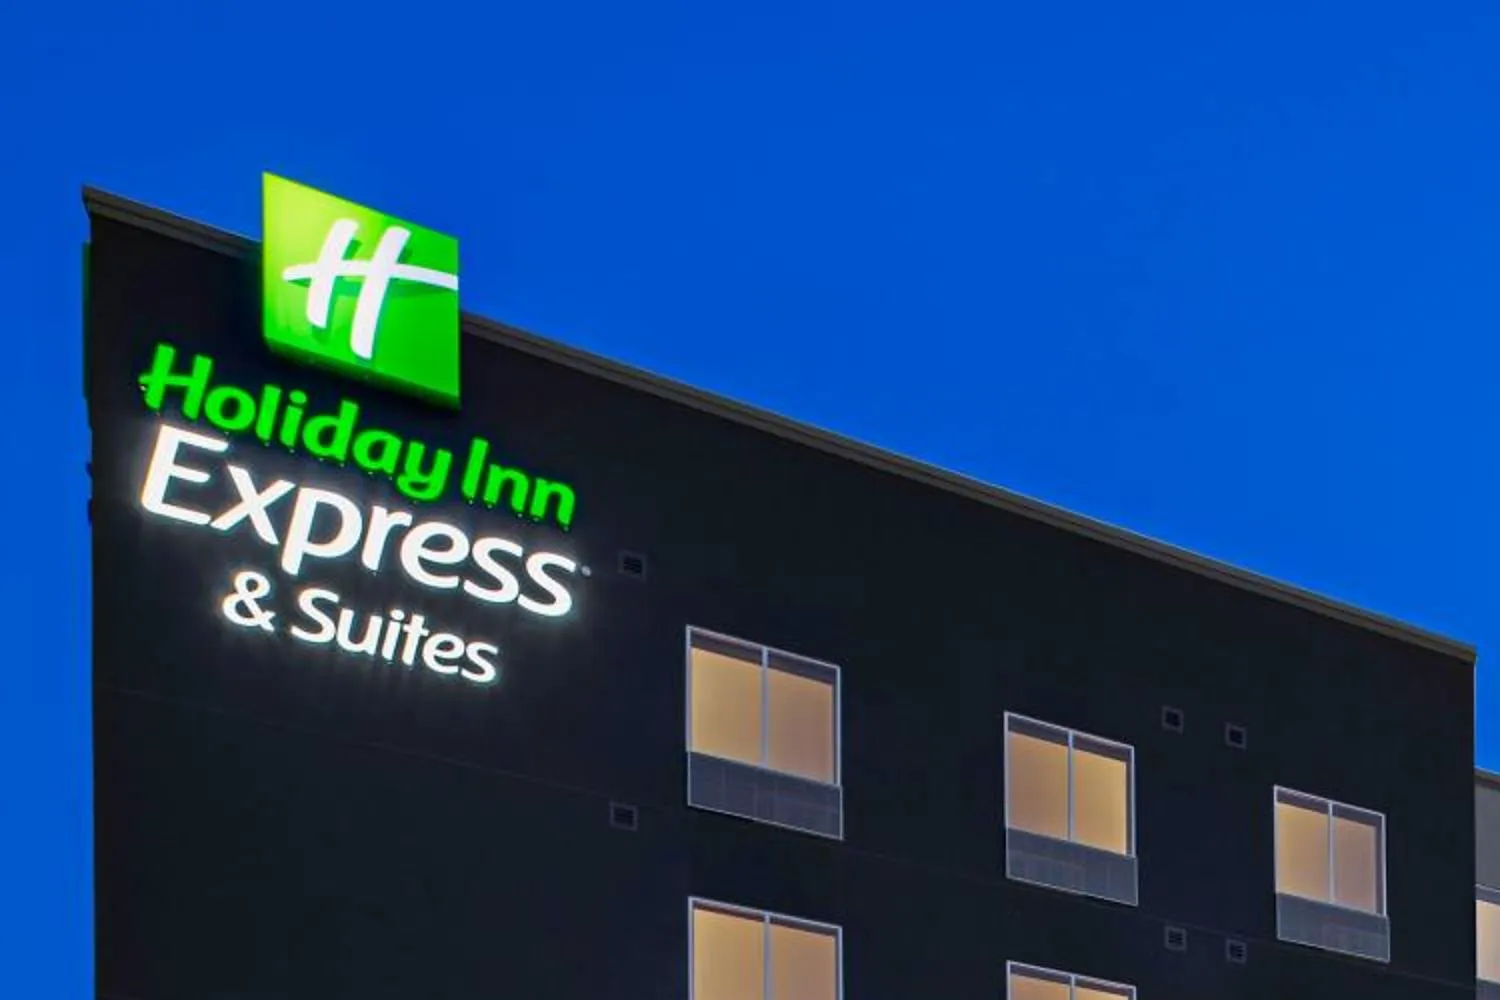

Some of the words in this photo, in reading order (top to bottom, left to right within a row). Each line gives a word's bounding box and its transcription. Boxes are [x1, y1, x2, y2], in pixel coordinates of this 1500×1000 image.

[282, 218, 458, 360] H
[138, 342, 453, 503] Holiday
[461, 438, 576, 527] Inn
[140, 424, 578, 618] Express
[221, 569, 276, 633] &
[290, 587, 499, 684] Suites
